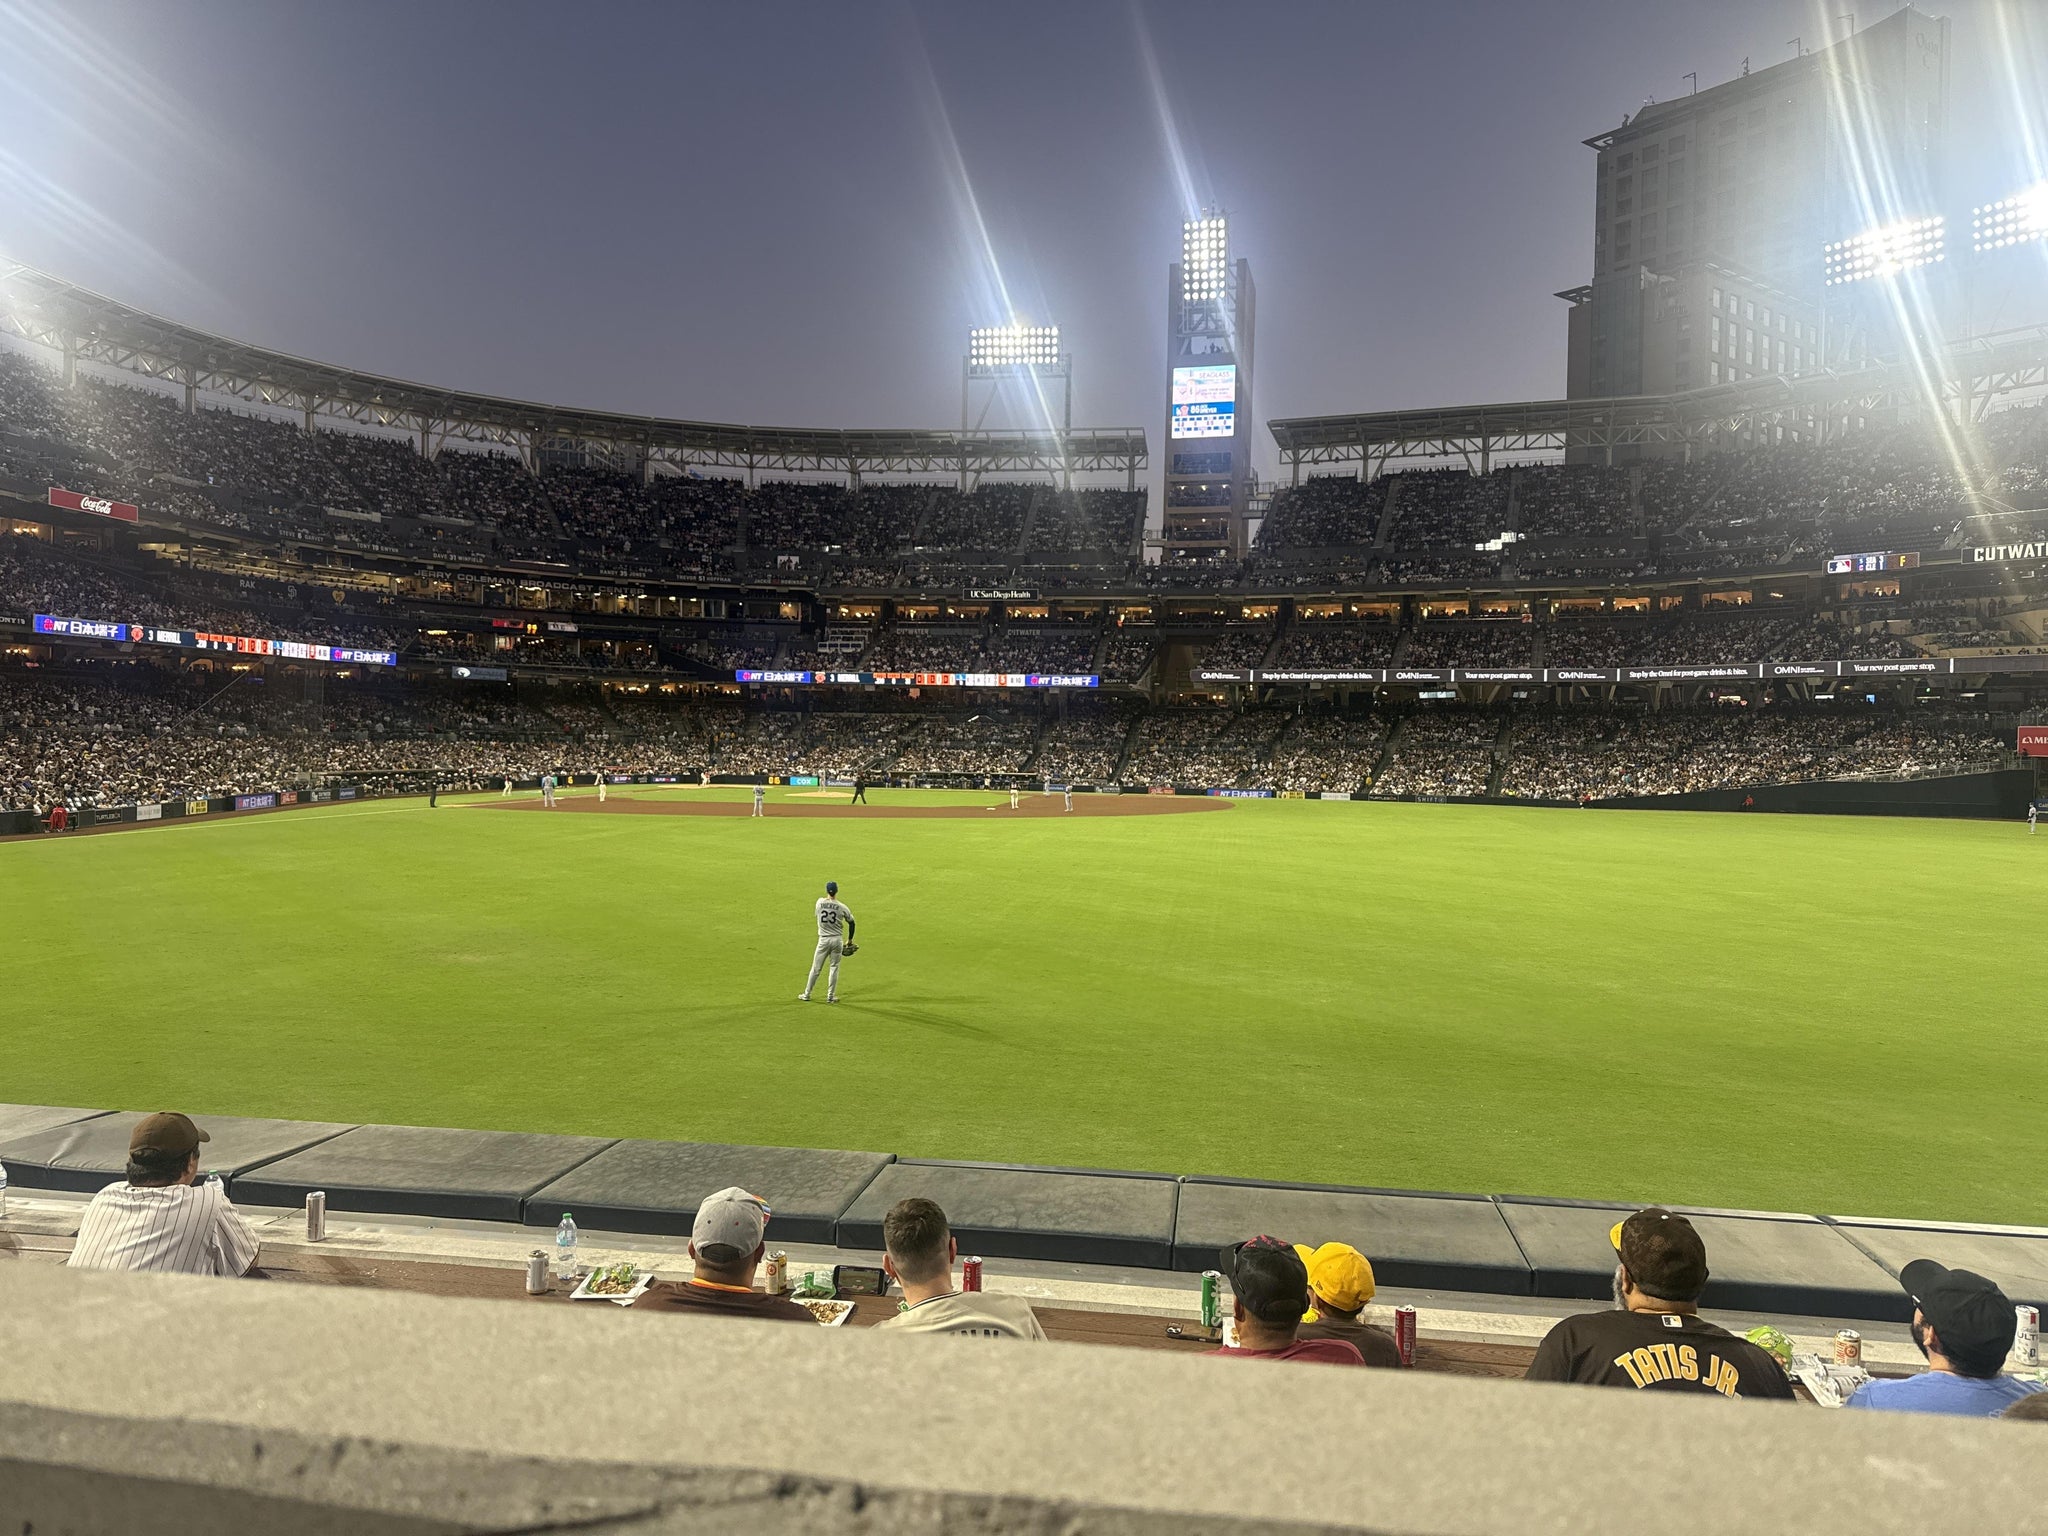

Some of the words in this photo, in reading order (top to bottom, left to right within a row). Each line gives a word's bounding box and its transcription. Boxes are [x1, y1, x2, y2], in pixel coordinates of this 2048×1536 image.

[280, 530, 295, 538] STEVE
[1974, 543, 2048, 562] CUTWAT
[1900, 556, 1906, 566] F
[240, 579, 256, 589] RAK
[414, 570, 452, 579] JERRY
[457, 573, 515, 585] COLEMAN
[520, 580, 594, 592] BROADCAST
[598, 585, 645, 594] CENTER
[993, 590, 1010, 599] Diego
[54, 621, 68, 632] NT
[70, 622, 118, 637] 日本端子
[148, 630, 154, 641] 3
[157, 630, 181, 644] MERRILL
[342, 652, 353, 660] NT
[830, 674, 835, 682] 3
[821, 910, 837, 924] 23
[1614, 1344, 1698, 1389] TATIS
